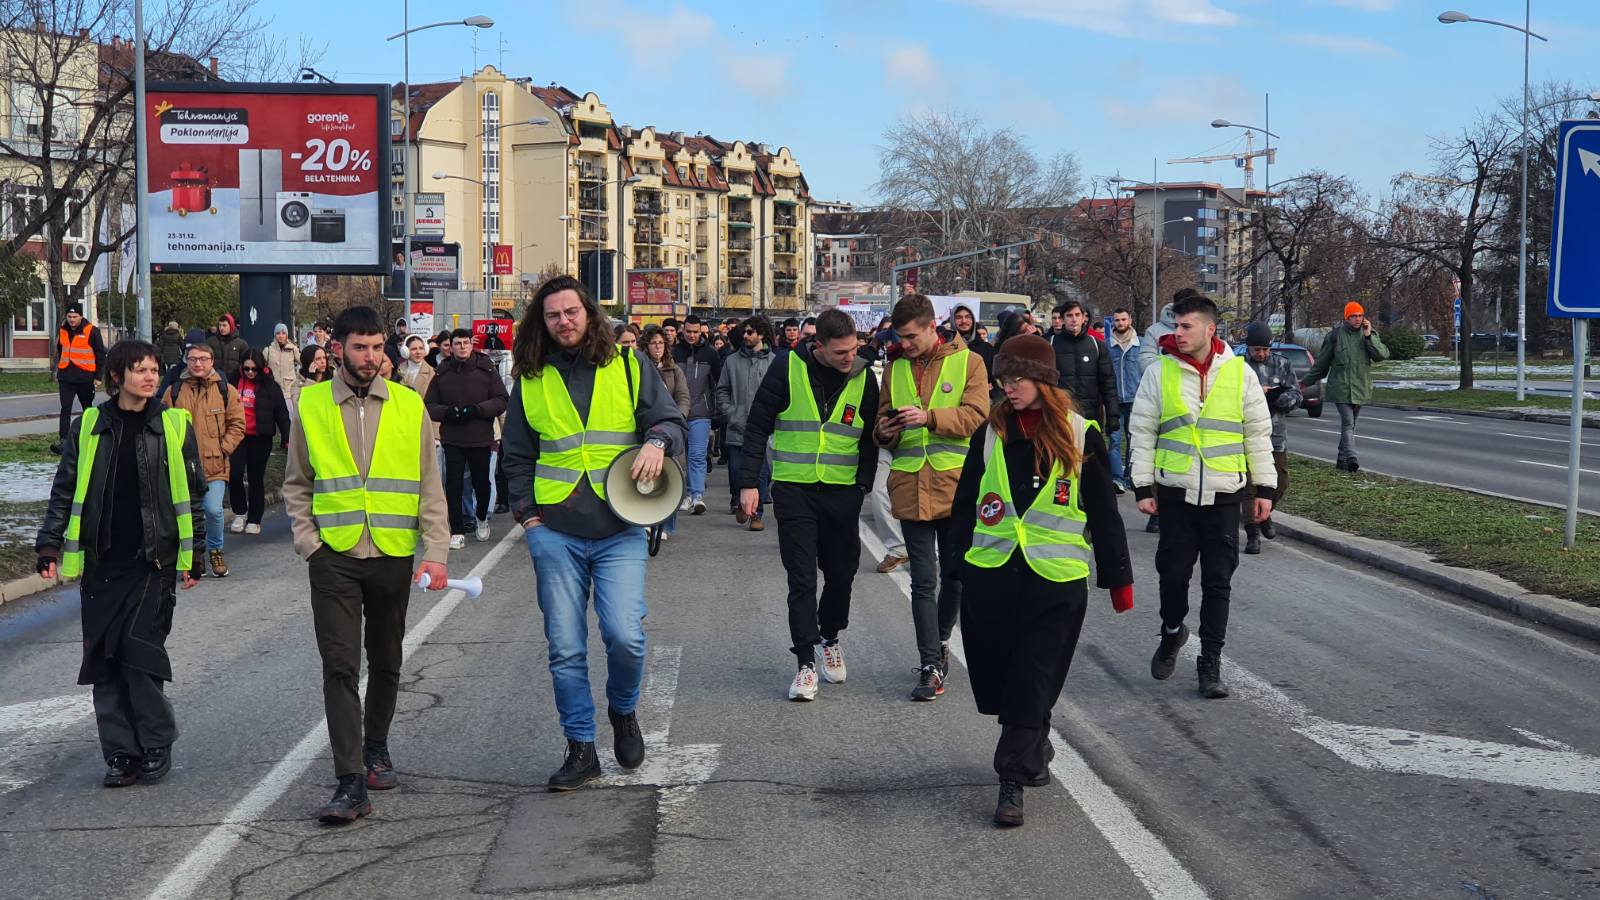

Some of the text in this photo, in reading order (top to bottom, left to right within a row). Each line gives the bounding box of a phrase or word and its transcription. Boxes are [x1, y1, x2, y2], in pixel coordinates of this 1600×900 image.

[171, 110, 239, 123] Tehnomanija
[307, 111, 349, 124] gorenje
[170, 126, 239, 142] Poklonmanija
[290, 138, 372, 171] -20%
[304, 174, 361, 183] BELA TEHNIKA
[167, 241, 246, 253] tehnomanija.rs
[486, 324, 494, 334] JE
